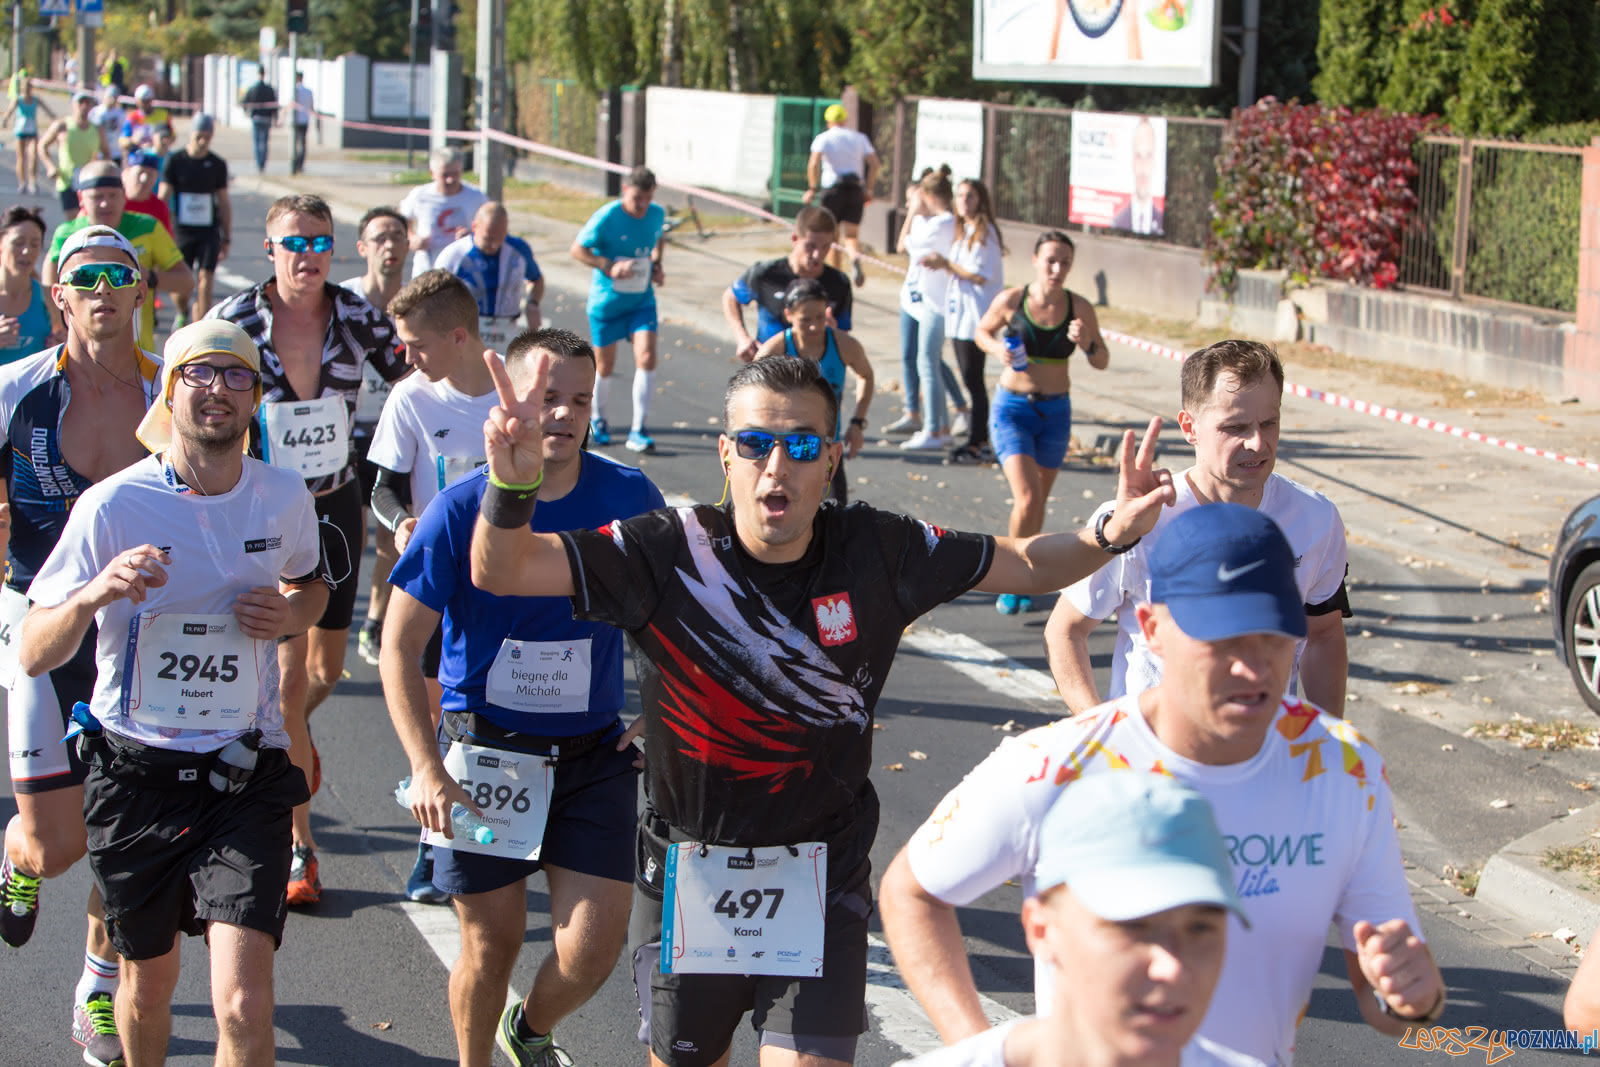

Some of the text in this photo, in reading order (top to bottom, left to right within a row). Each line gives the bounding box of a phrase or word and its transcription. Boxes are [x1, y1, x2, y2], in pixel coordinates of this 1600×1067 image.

[283, 423, 336, 448] 4423
[31, 427, 61, 497] GRANFONDO
[157, 651, 239, 683] 2945
[511, 668, 568, 685] biegnę dla
[181, 688, 214, 698] Hubert
[516, 684, 561, 697] Michała
[714, 888, 785, 920] 497
[733, 926, 763, 937] Karol
